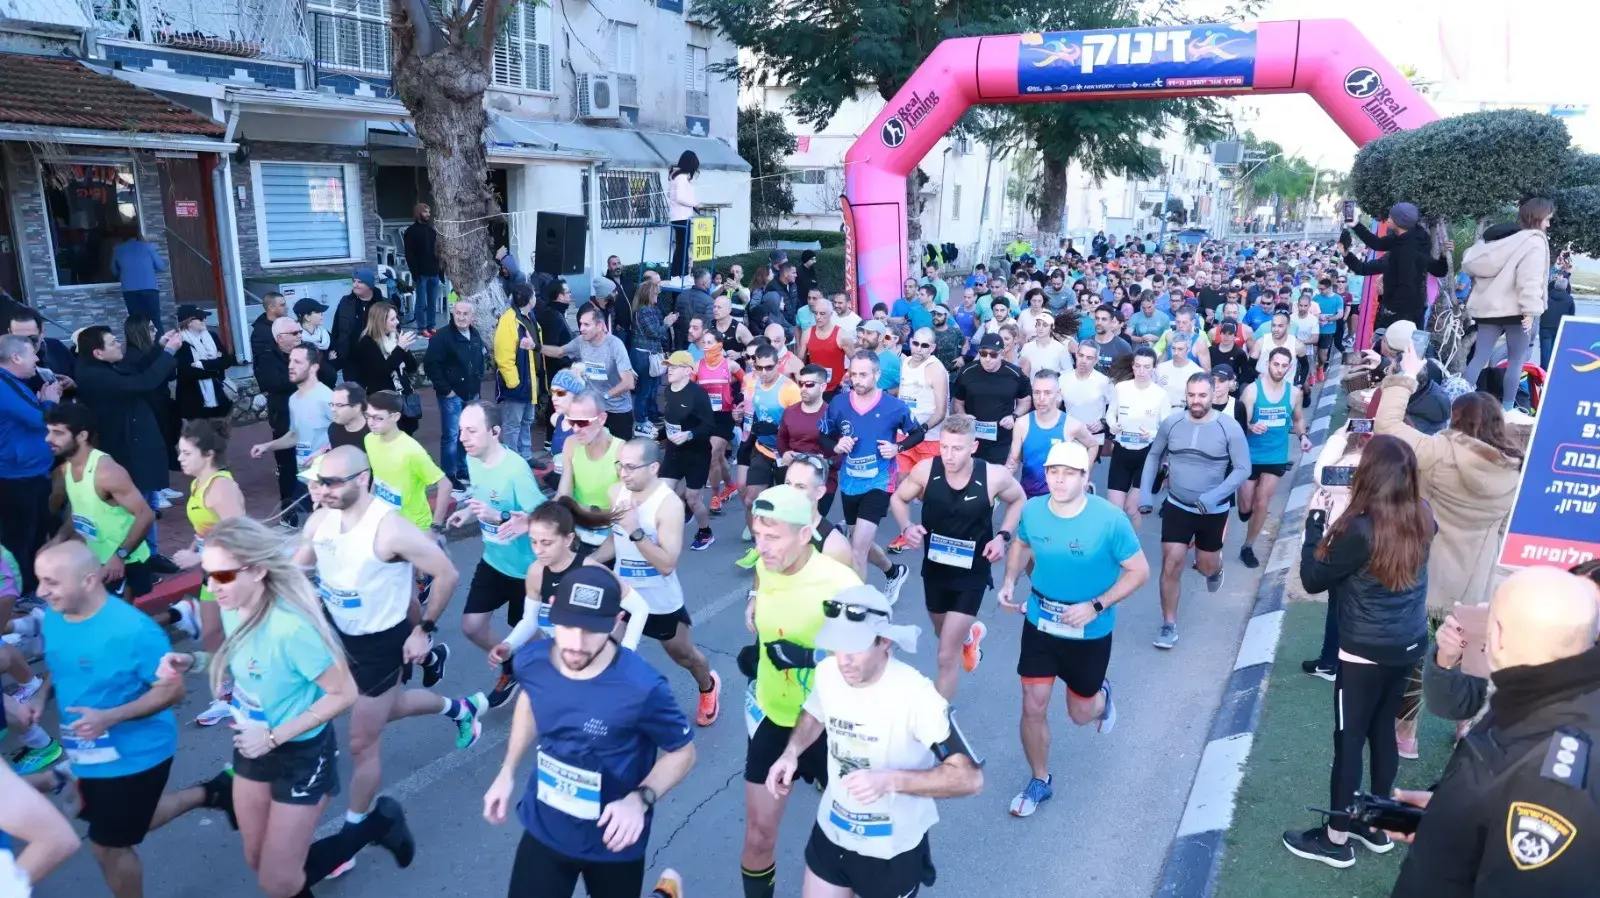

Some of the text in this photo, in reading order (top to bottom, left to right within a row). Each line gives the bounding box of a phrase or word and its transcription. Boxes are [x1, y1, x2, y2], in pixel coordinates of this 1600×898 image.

[1081, 30, 1191, 74] זינוק
[897, 91, 921, 120] Real
[903, 90, 940, 130] Timing
[1376, 87, 1408, 116] Real
[849, 822, 866, 836] 70
